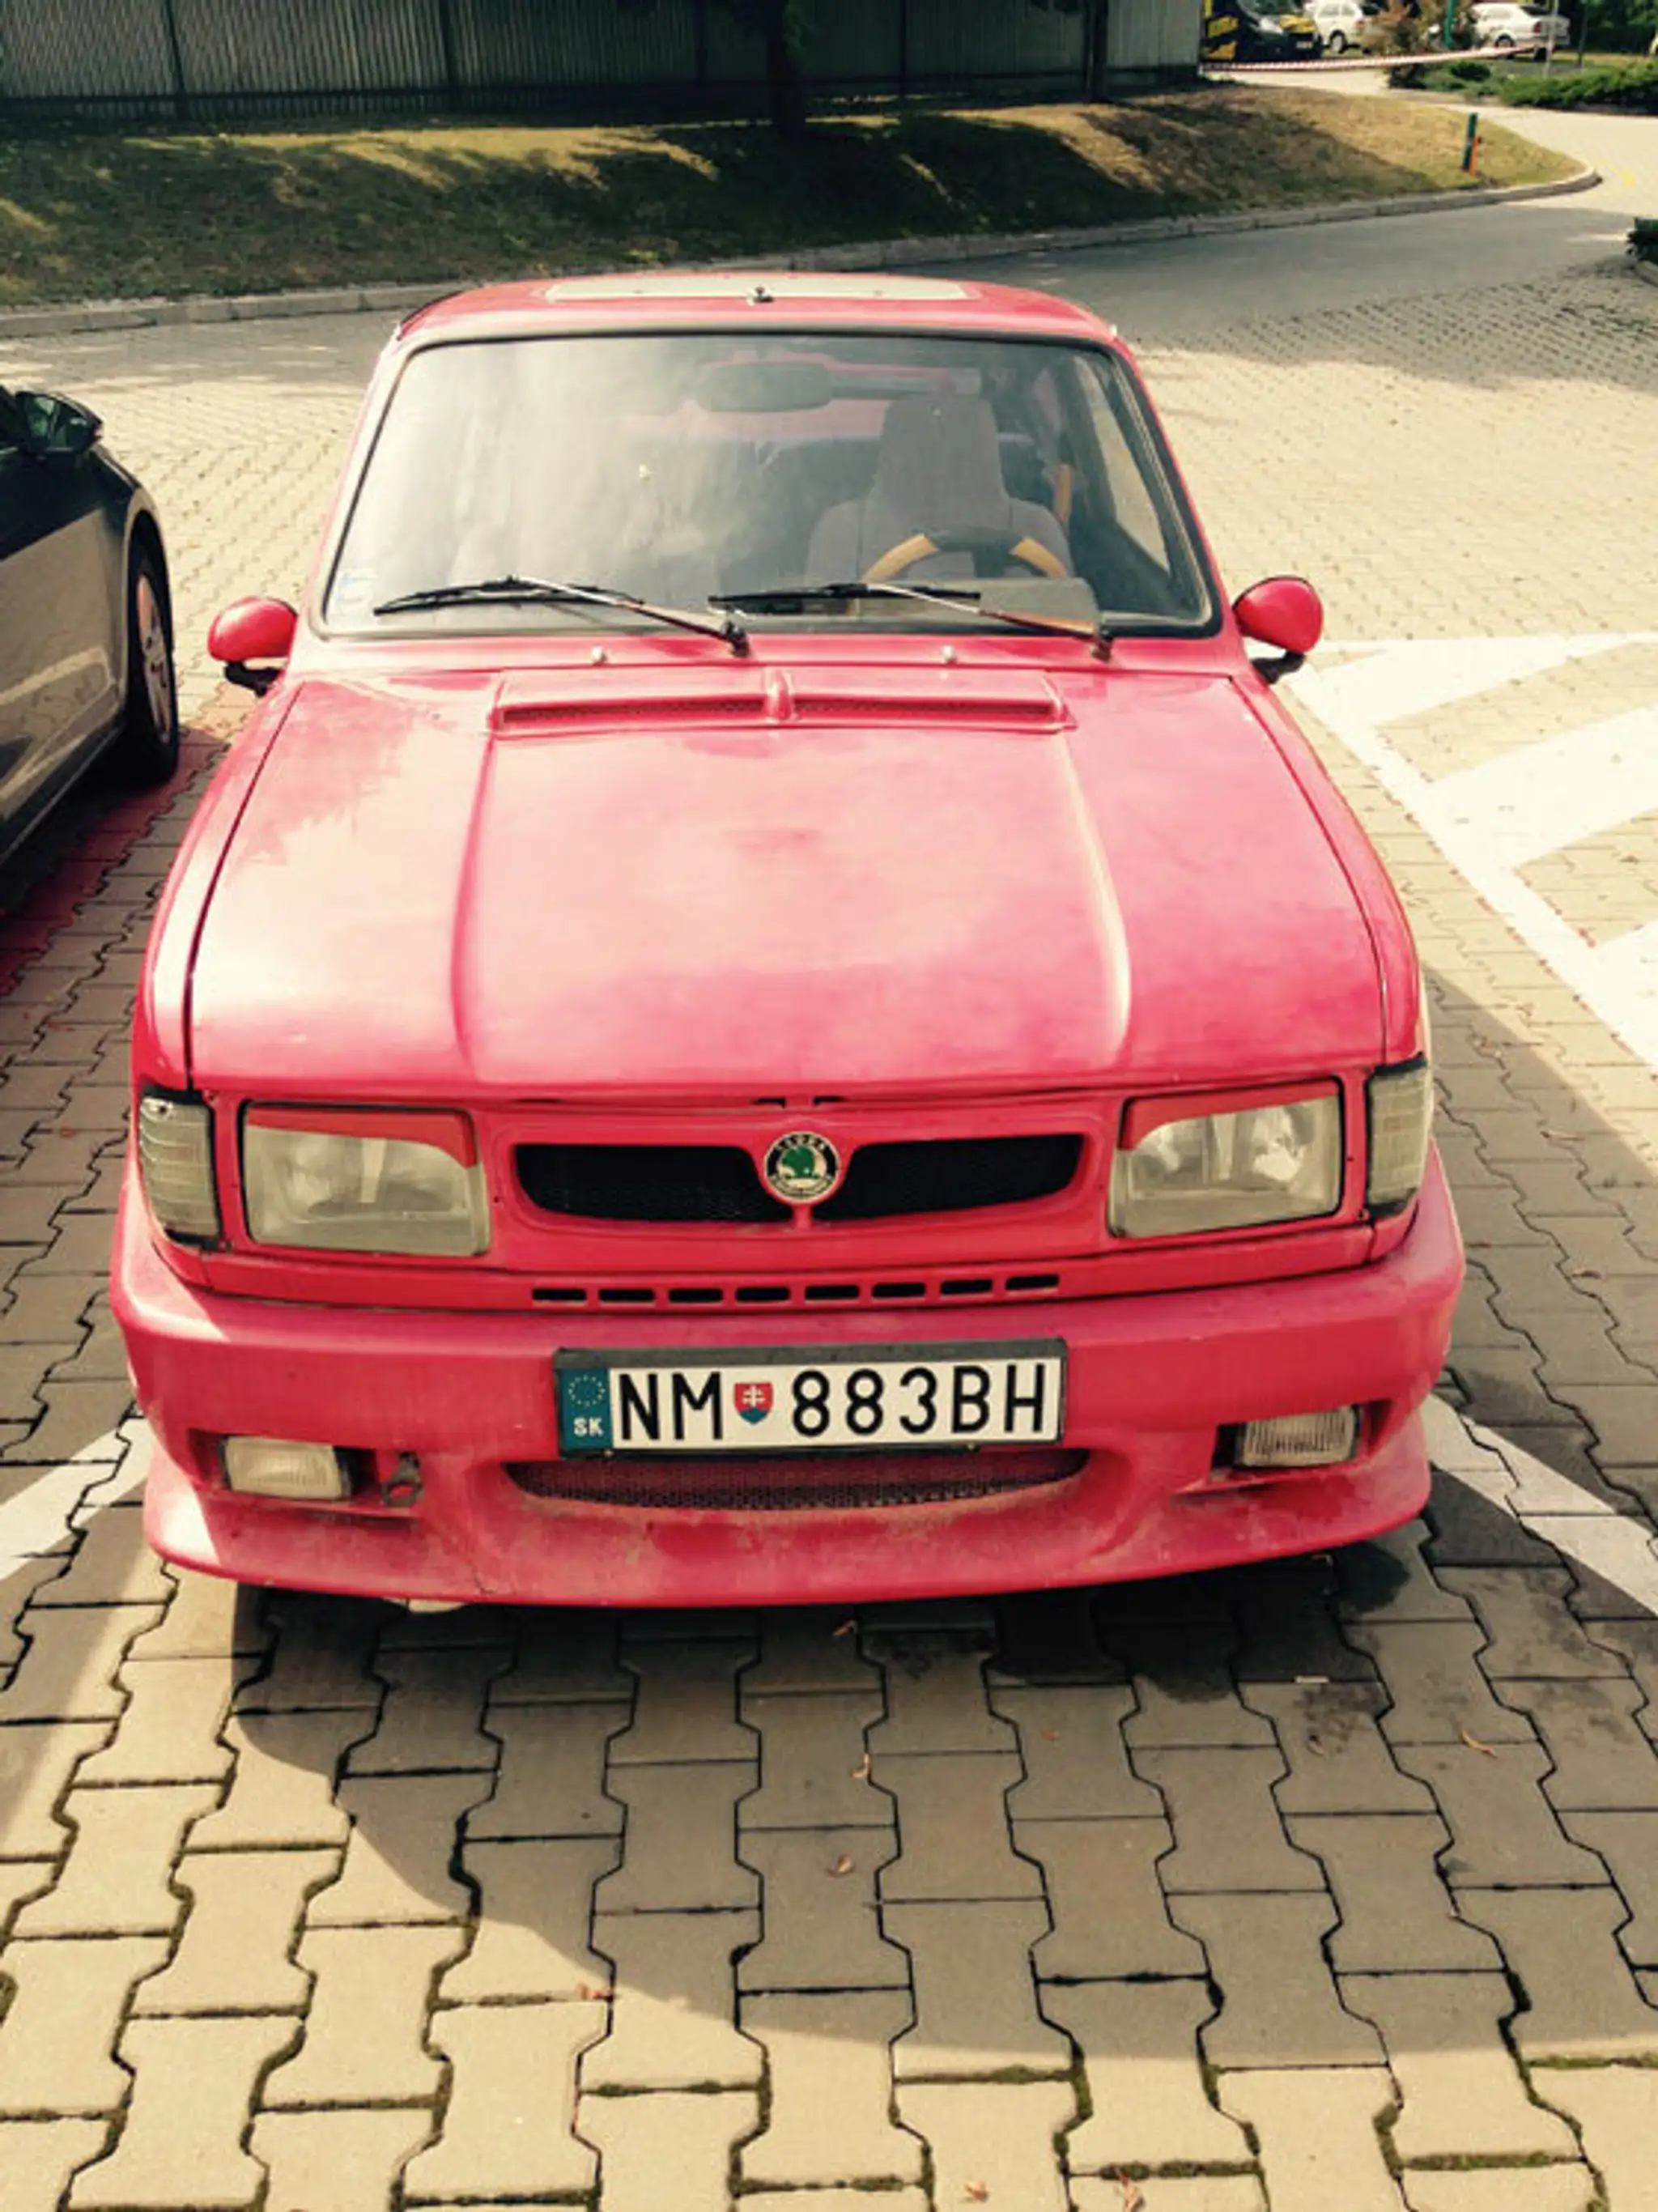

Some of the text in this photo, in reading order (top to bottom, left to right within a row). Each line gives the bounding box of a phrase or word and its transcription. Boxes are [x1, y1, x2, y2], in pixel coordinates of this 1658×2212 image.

[619, 1364, 1045, 1440] NM 883BH
[572, 1416, 605, 1438] SK
